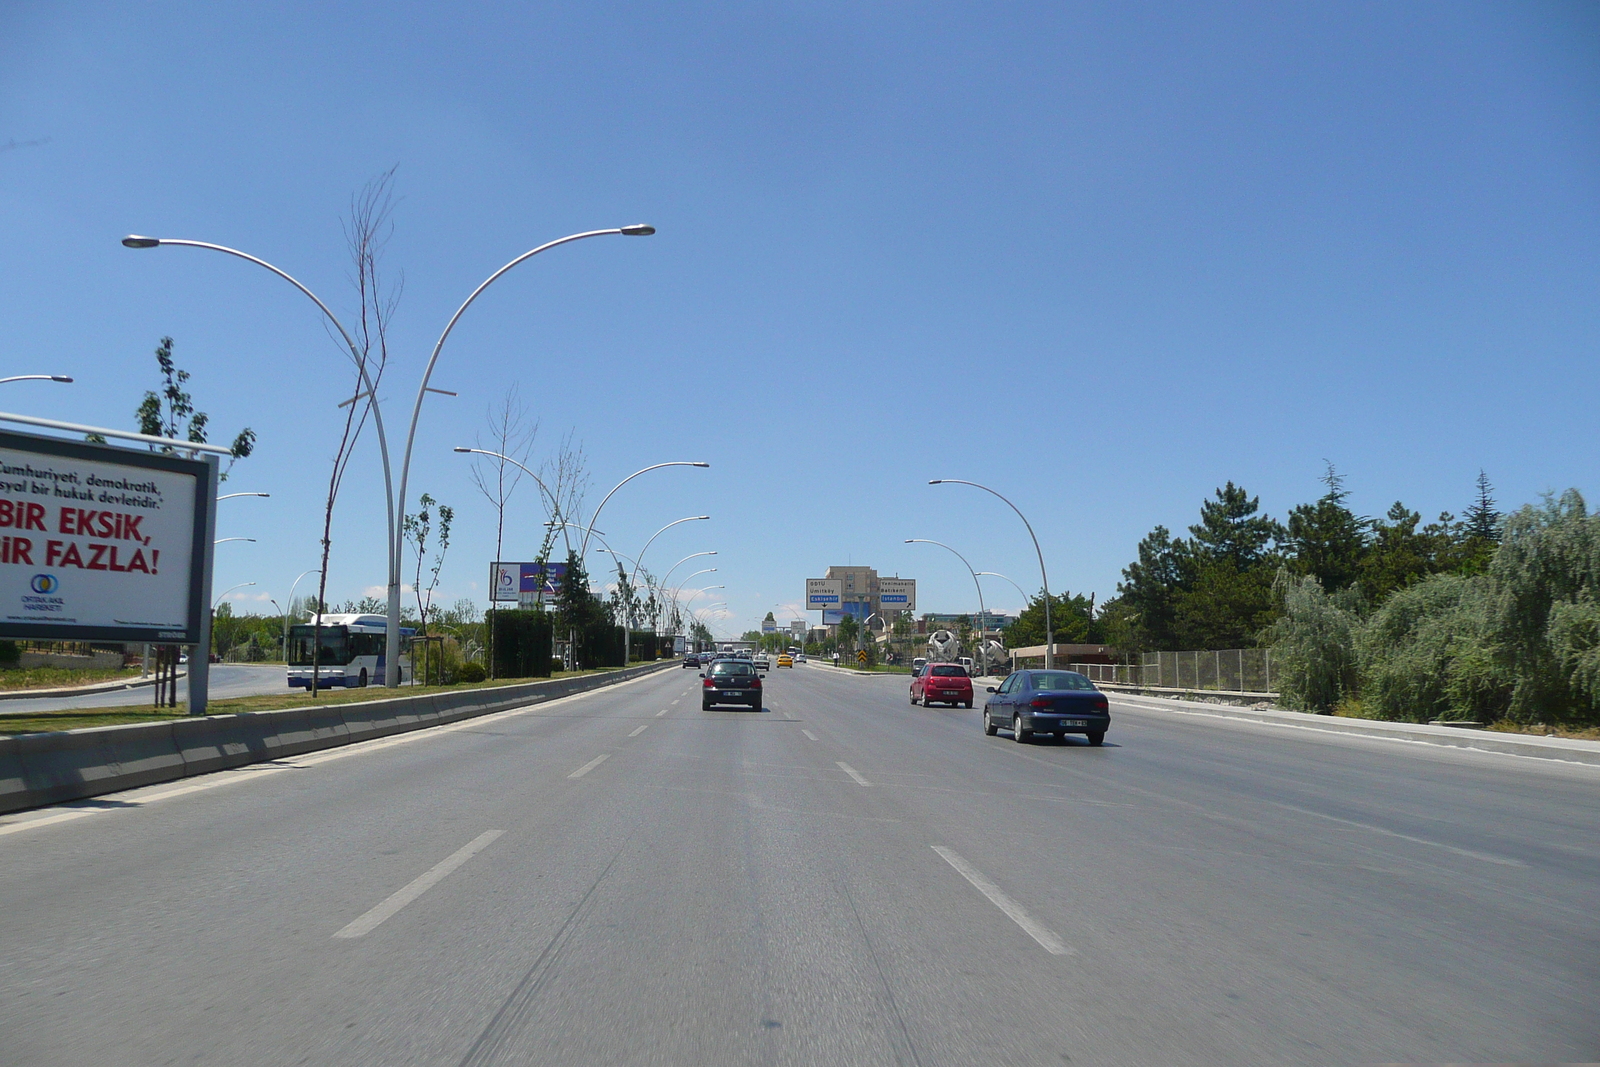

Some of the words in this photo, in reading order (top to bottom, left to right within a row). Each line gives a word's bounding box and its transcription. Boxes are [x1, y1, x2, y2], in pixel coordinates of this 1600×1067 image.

[31, 481, 50, 495] bir
[54, 483, 95, 501] hukuk
[86, 473, 161, 496] demokratik,
[0, 536, 34, 566] iR
[45, 539, 160, 575] FAZLA!
